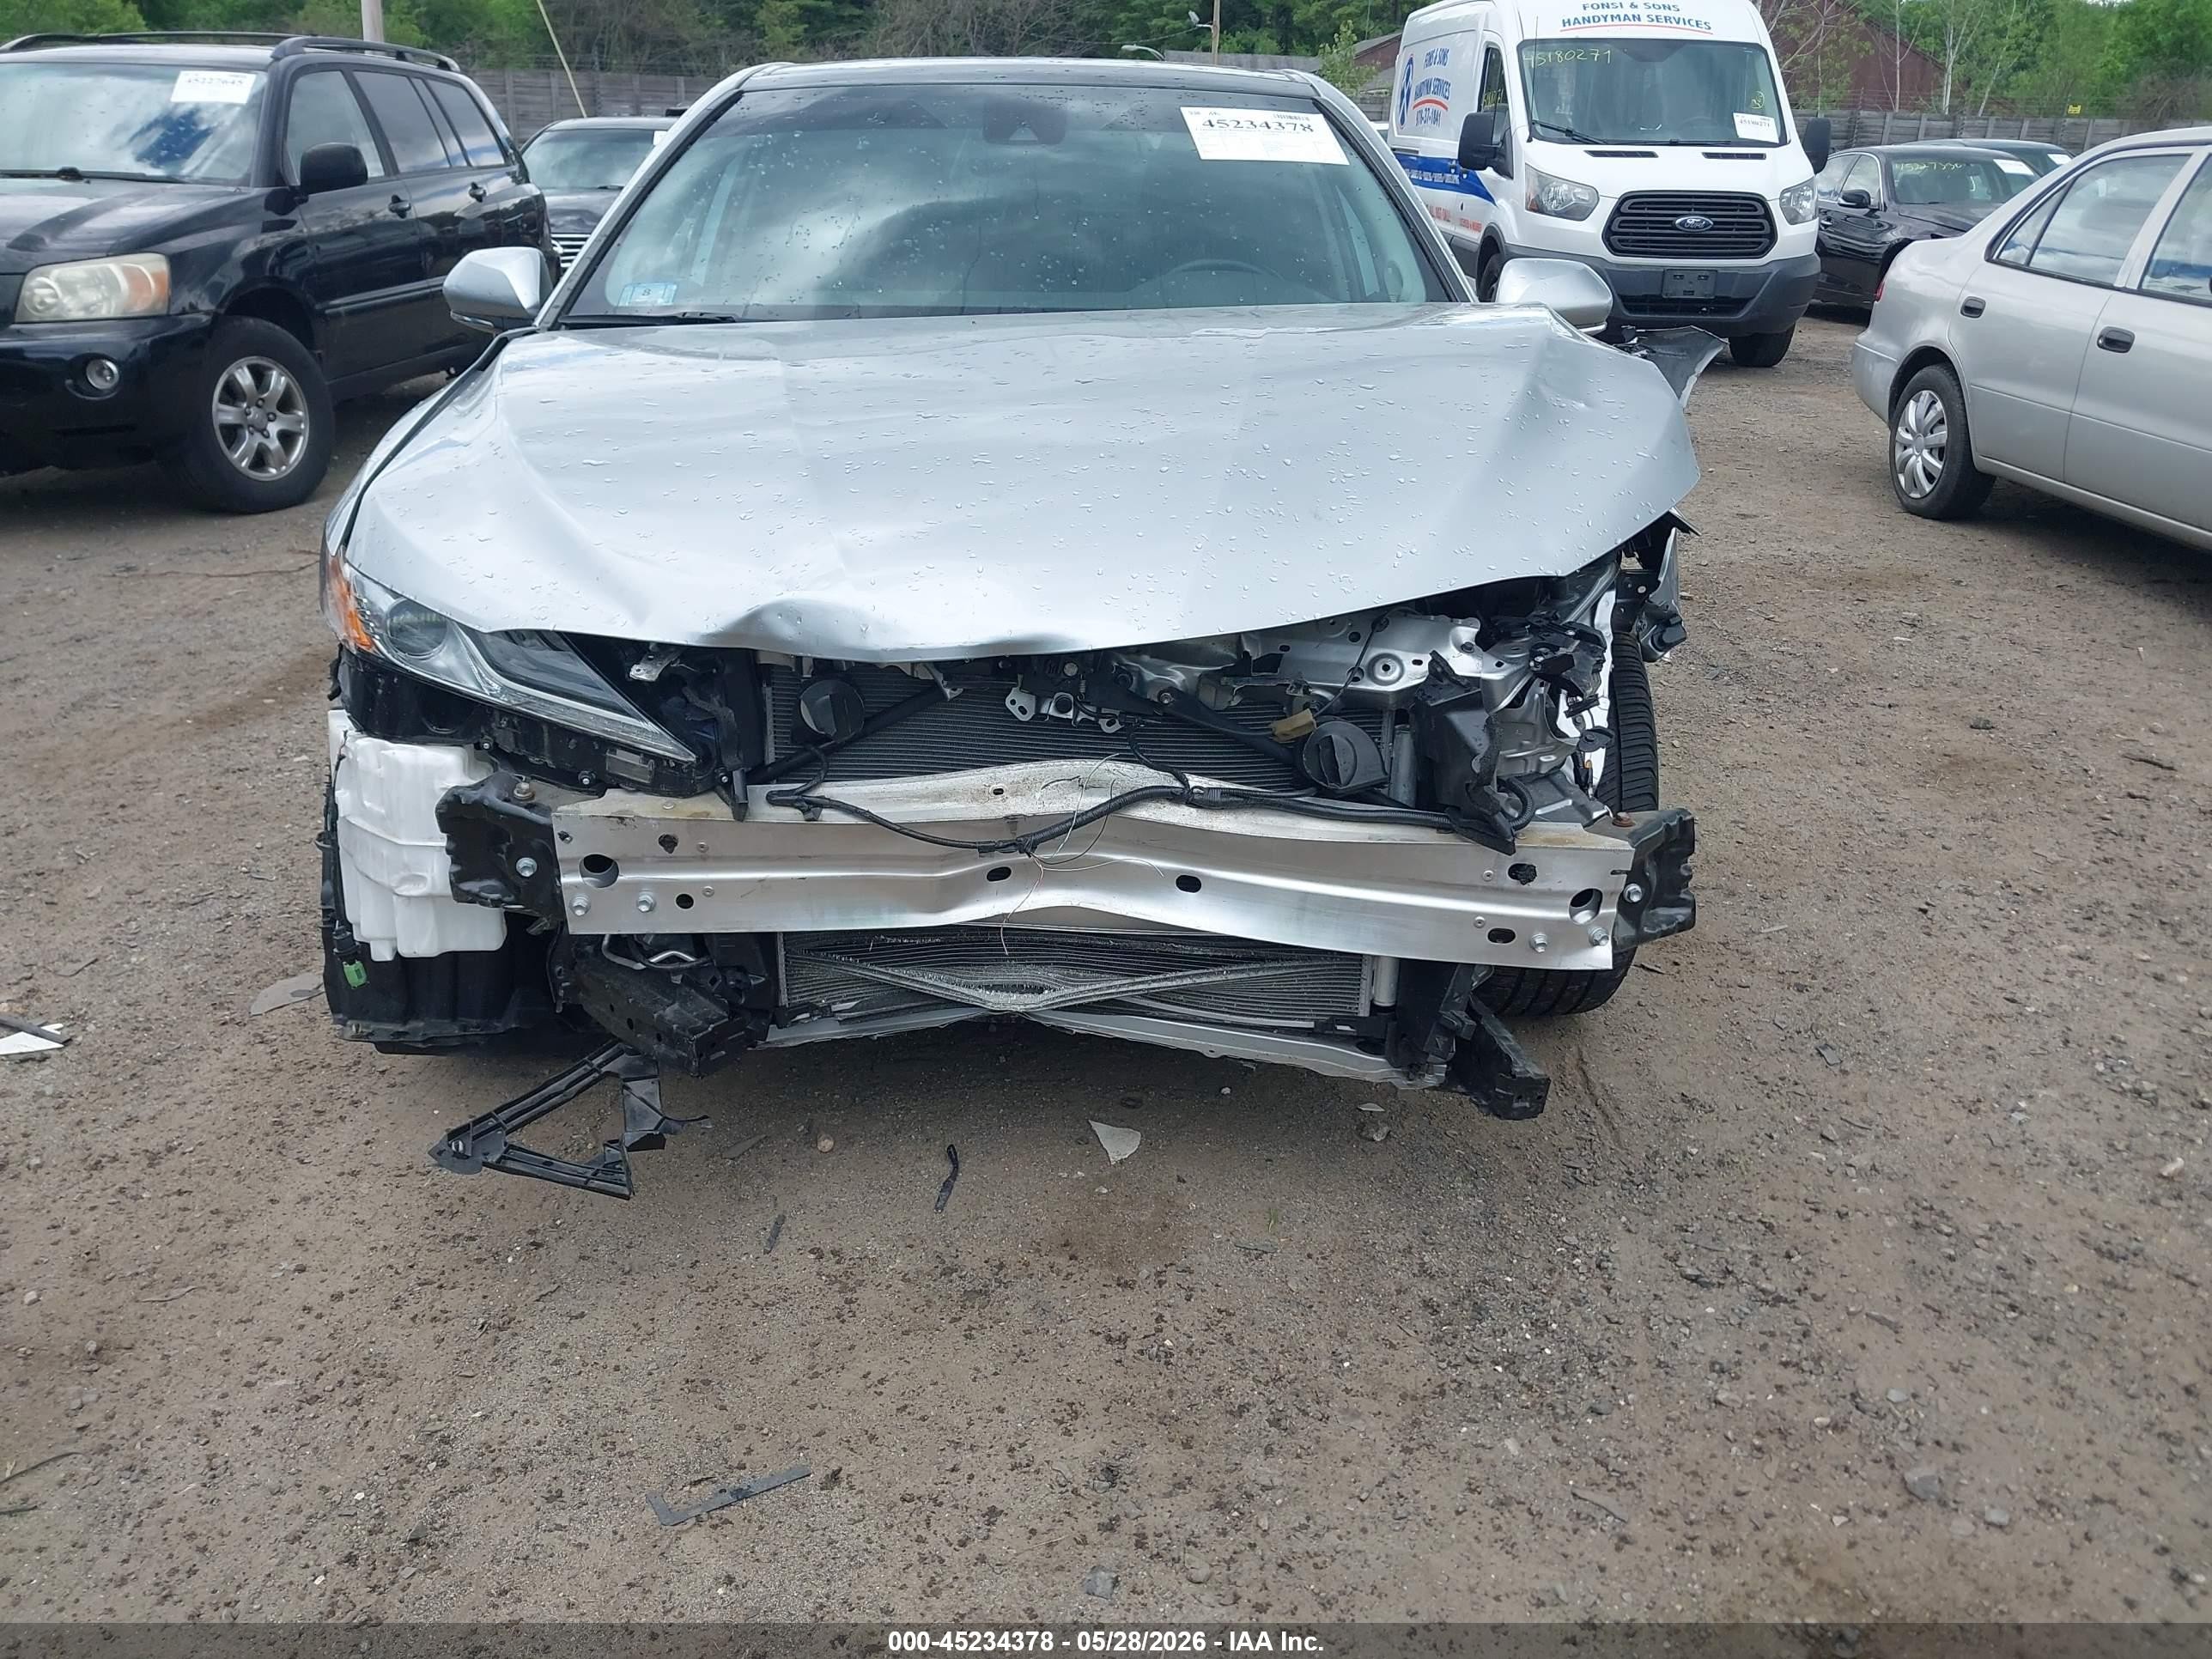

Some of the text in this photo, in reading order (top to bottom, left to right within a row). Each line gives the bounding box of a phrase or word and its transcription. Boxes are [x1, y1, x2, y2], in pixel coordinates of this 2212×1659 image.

[1582, 2, 1623, 11] FONSI
[1644, 2, 1680, 12] SONS
[1562, 13, 1712, 30] HANDYMAN SERVICES
[1523, 48, 1611, 68] 45180271
[1201, 118, 1314, 133] 45234378
[1684, 218, 1706, 228] Ford
